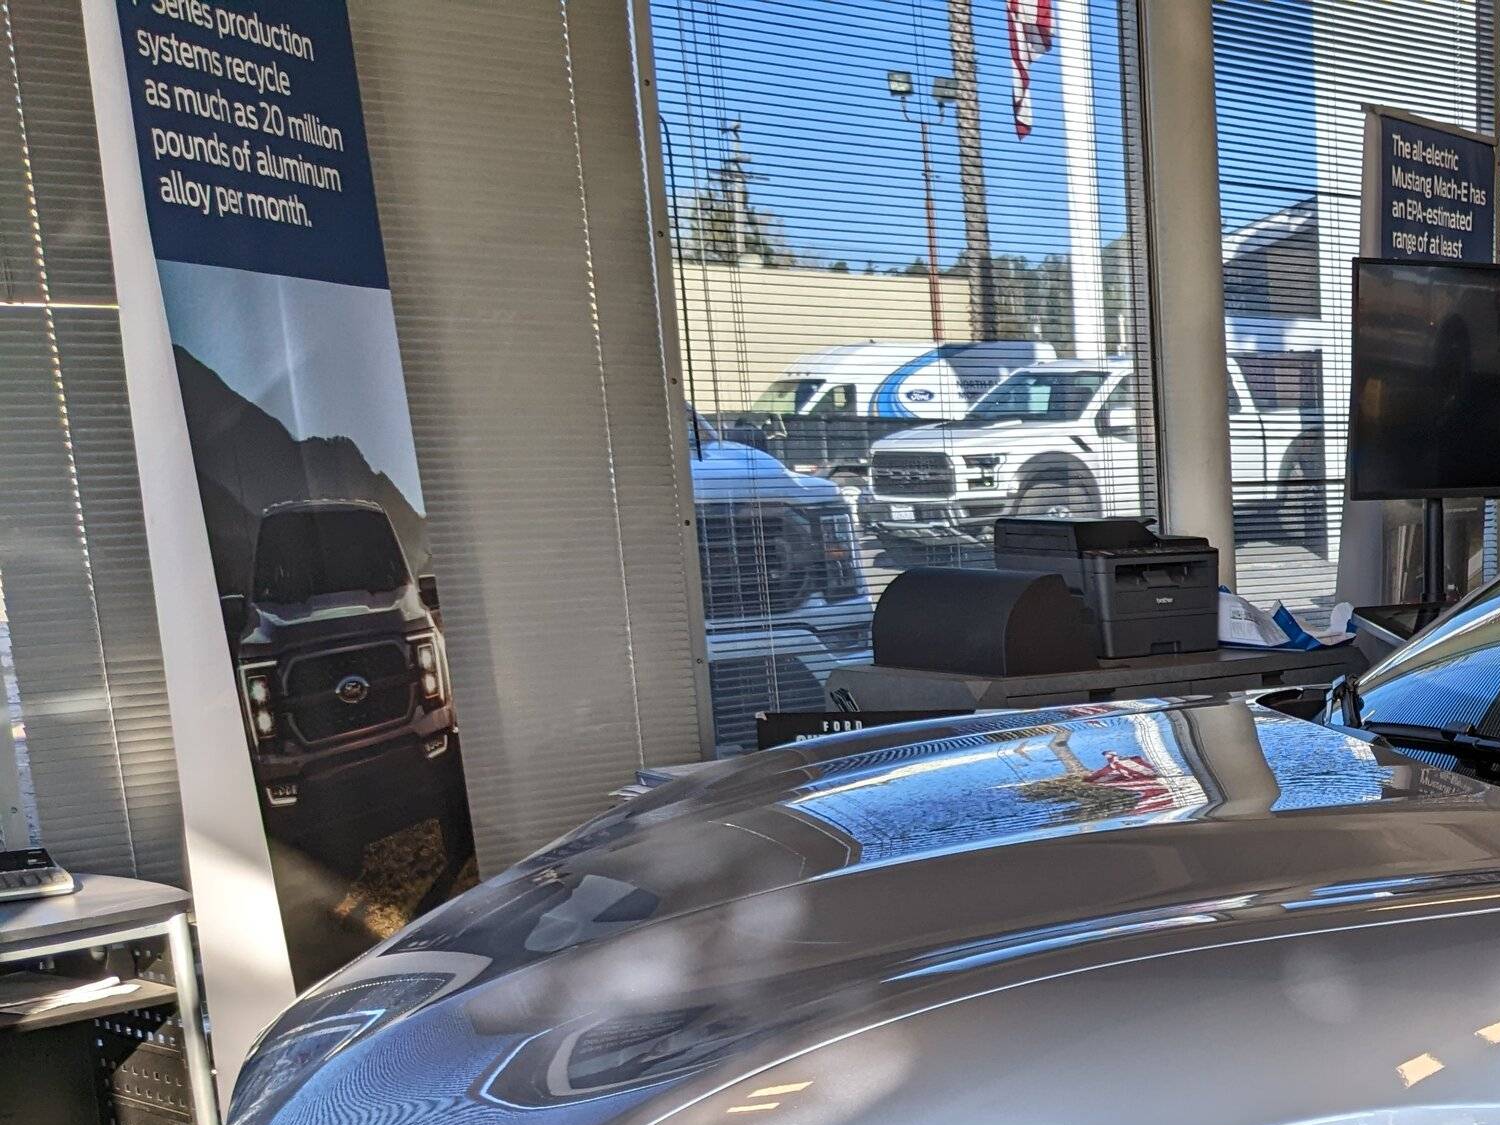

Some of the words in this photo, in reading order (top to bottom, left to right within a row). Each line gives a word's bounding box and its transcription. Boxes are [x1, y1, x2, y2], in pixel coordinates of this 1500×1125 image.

[216, 8, 315, 62] production
[137, 29, 223, 77] systems
[224, 55, 292, 96] recycle
[143, 78, 171, 109] as
[174, 85, 230, 123] much
[234, 102, 258, 131] as
[262, 101, 285, 138] 20
[288, 113, 344, 152] million
[151, 127, 231, 168] pounds
[233, 140, 252, 172] of
[256, 145, 342, 192] aluminum
[1392, 133, 1411, 159] The
[1412, 140, 1459, 171] all-electric
[159, 170, 211, 215] alloy
[215, 185, 243, 217] per
[246, 192, 313, 228] month.
[1391, 165, 1432, 199] Mustang
[1434, 175, 1468, 202] Mach-E
[1470, 182, 1486, 206] has
[1392, 200, 1405, 219] an
[1406, 198, 1473, 232] EPA-estimated
[1392, 231, 1416, 254] range
[1417, 231, 1429, 253] of
[1429, 237, 1440, 255] at
[1440, 234, 1463, 259] least
[822, 720, 862, 732] FORD
